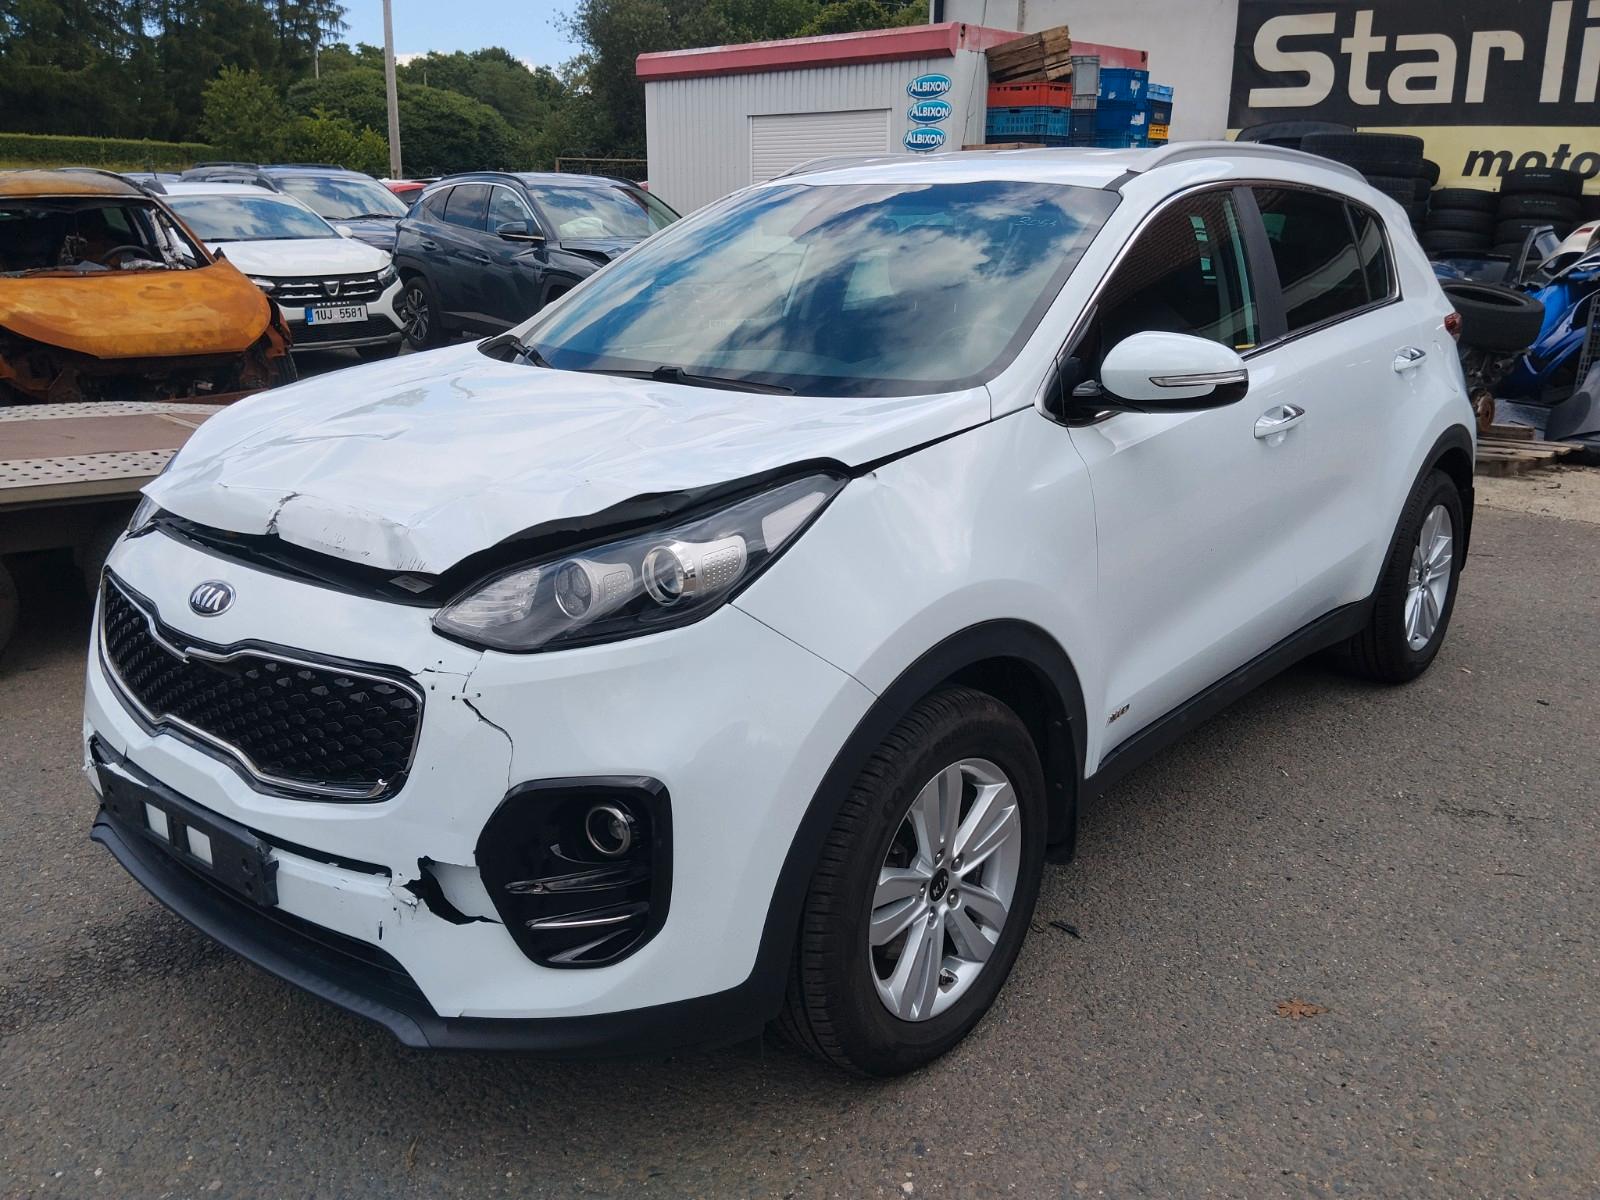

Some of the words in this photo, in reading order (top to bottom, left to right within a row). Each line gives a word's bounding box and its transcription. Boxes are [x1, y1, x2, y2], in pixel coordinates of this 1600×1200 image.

[1247, 0, 1600, 108] Starli
[910, 79, 949, 92] ALBIXON
[910, 103, 949, 117] ALBIXON
[905, 130, 944, 145] ALBIXON
[315, 309, 333, 321] 1UJ
[339, 307, 363, 319] 5581
[191, 584, 226, 611] KIA
